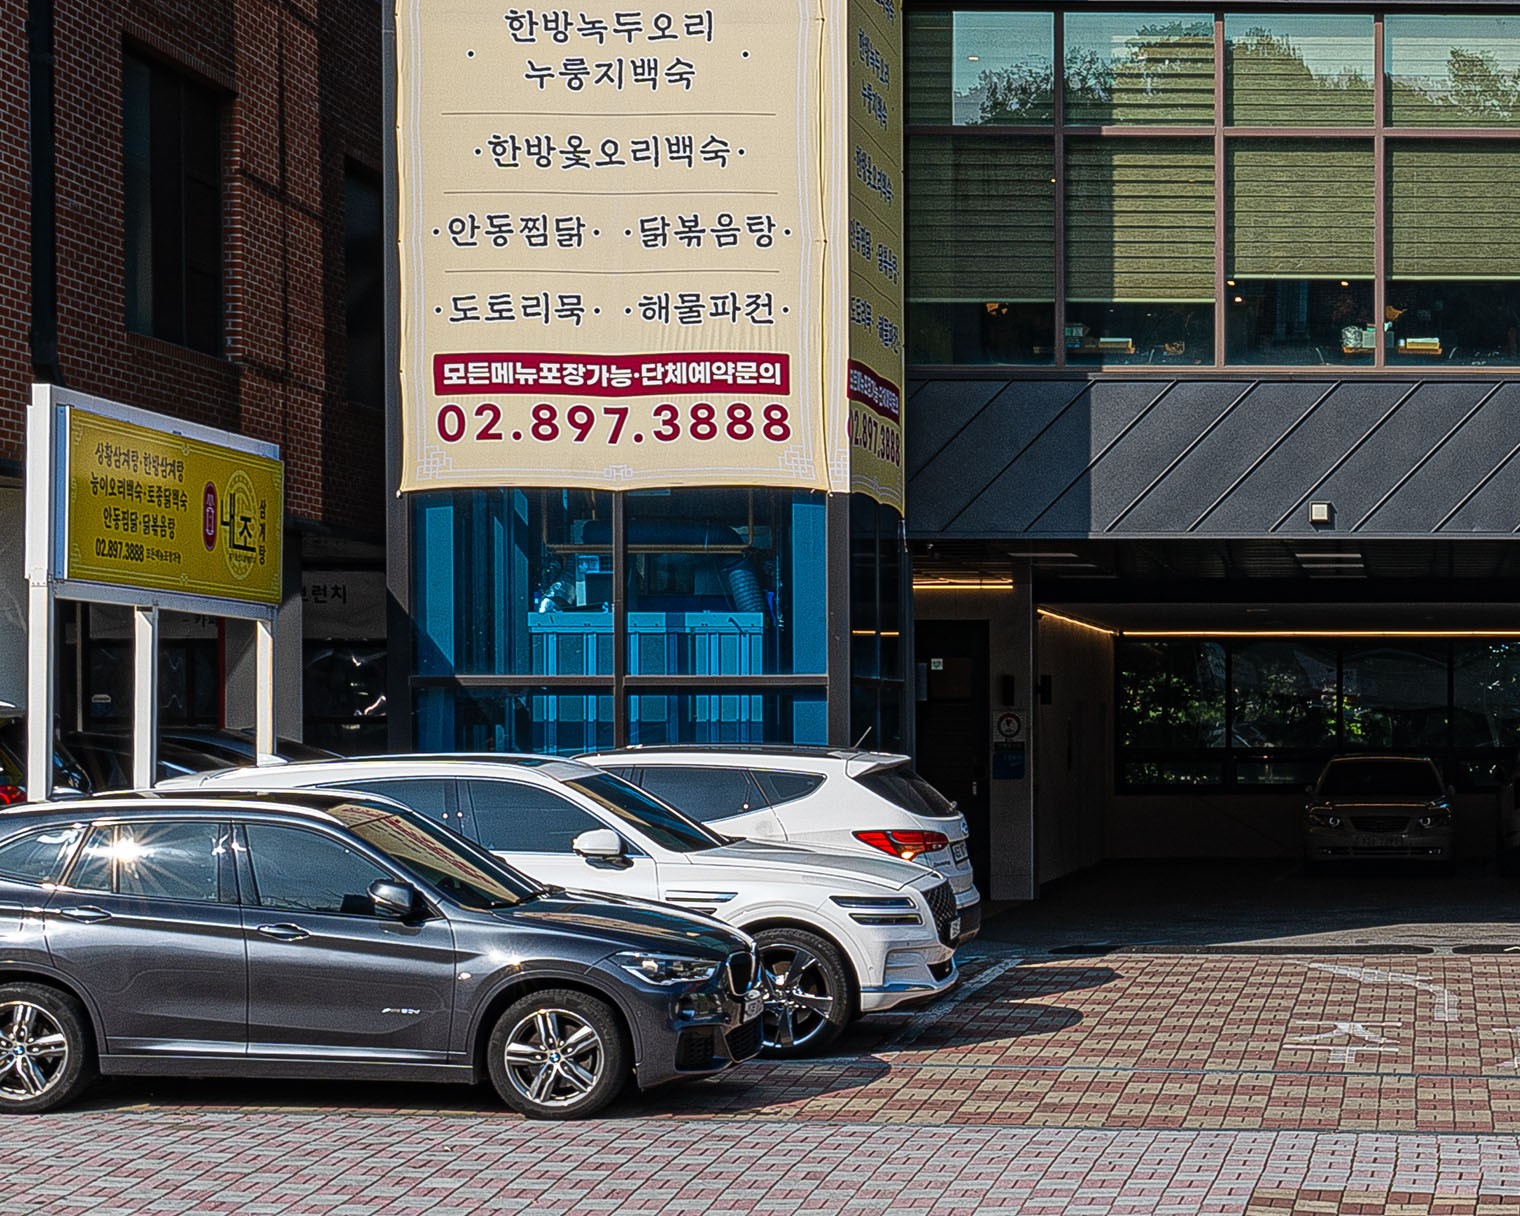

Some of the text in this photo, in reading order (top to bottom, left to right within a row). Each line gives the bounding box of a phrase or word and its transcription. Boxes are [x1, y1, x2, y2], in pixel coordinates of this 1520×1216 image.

[504, 10, 714, 44] 한방녹두오리
[525, 58, 696, 91] 누룽지백숙
[488, 135, 732, 168] 한방옻오리백숙
[448, 213, 777, 249] 안동찜닭 닭볶음탕
[449, 292, 777, 325] 도토리묵 해물파전
[437, 404, 792, 444] 02.897.3888
[847, 408, 900, 467] 02.897.3888
[220, 492, 257, 553] 내조
[96, 538, 144, 562] 02.897.3888
